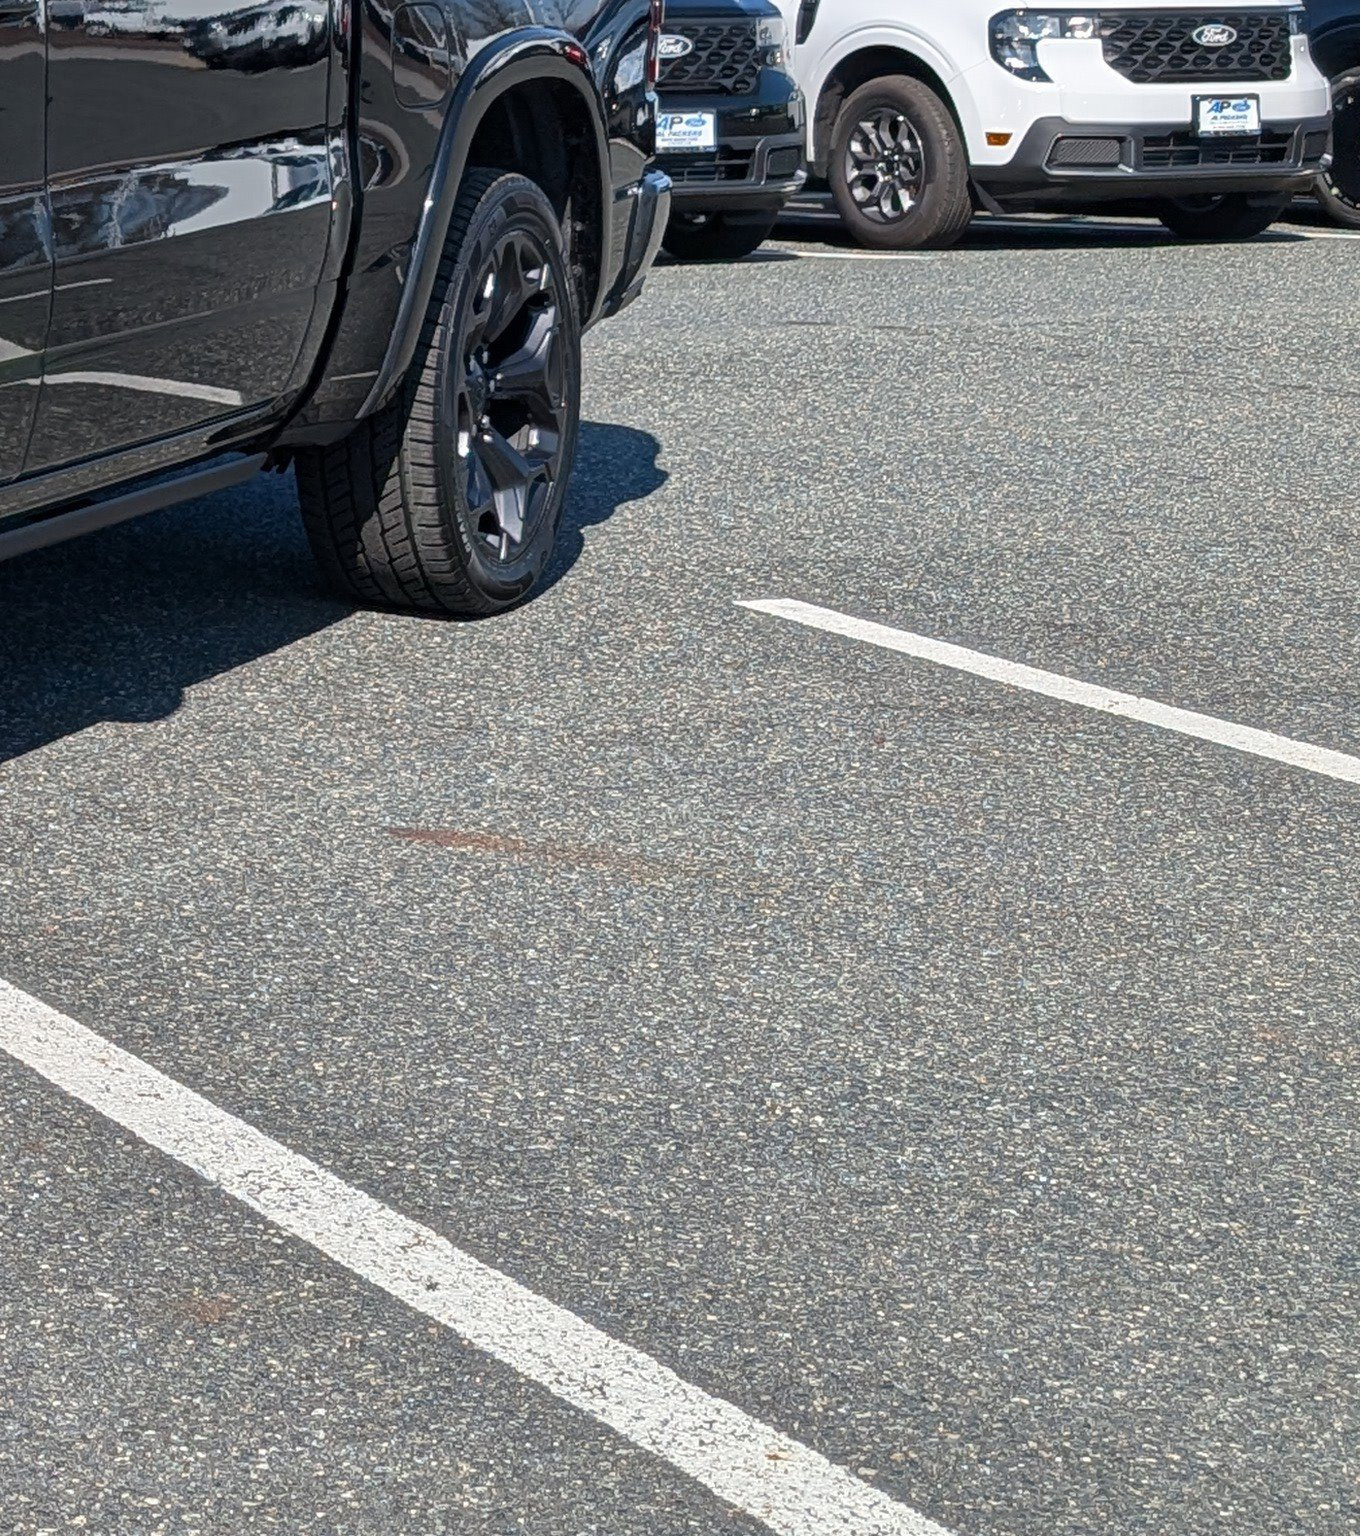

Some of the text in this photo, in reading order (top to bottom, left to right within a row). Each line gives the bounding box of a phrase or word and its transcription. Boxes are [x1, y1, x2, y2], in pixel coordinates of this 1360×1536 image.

[1200, 26, 1230, 44] Ford
[1207, 100, 1231, 114] AP
[656, 116, 683, 130] AP
